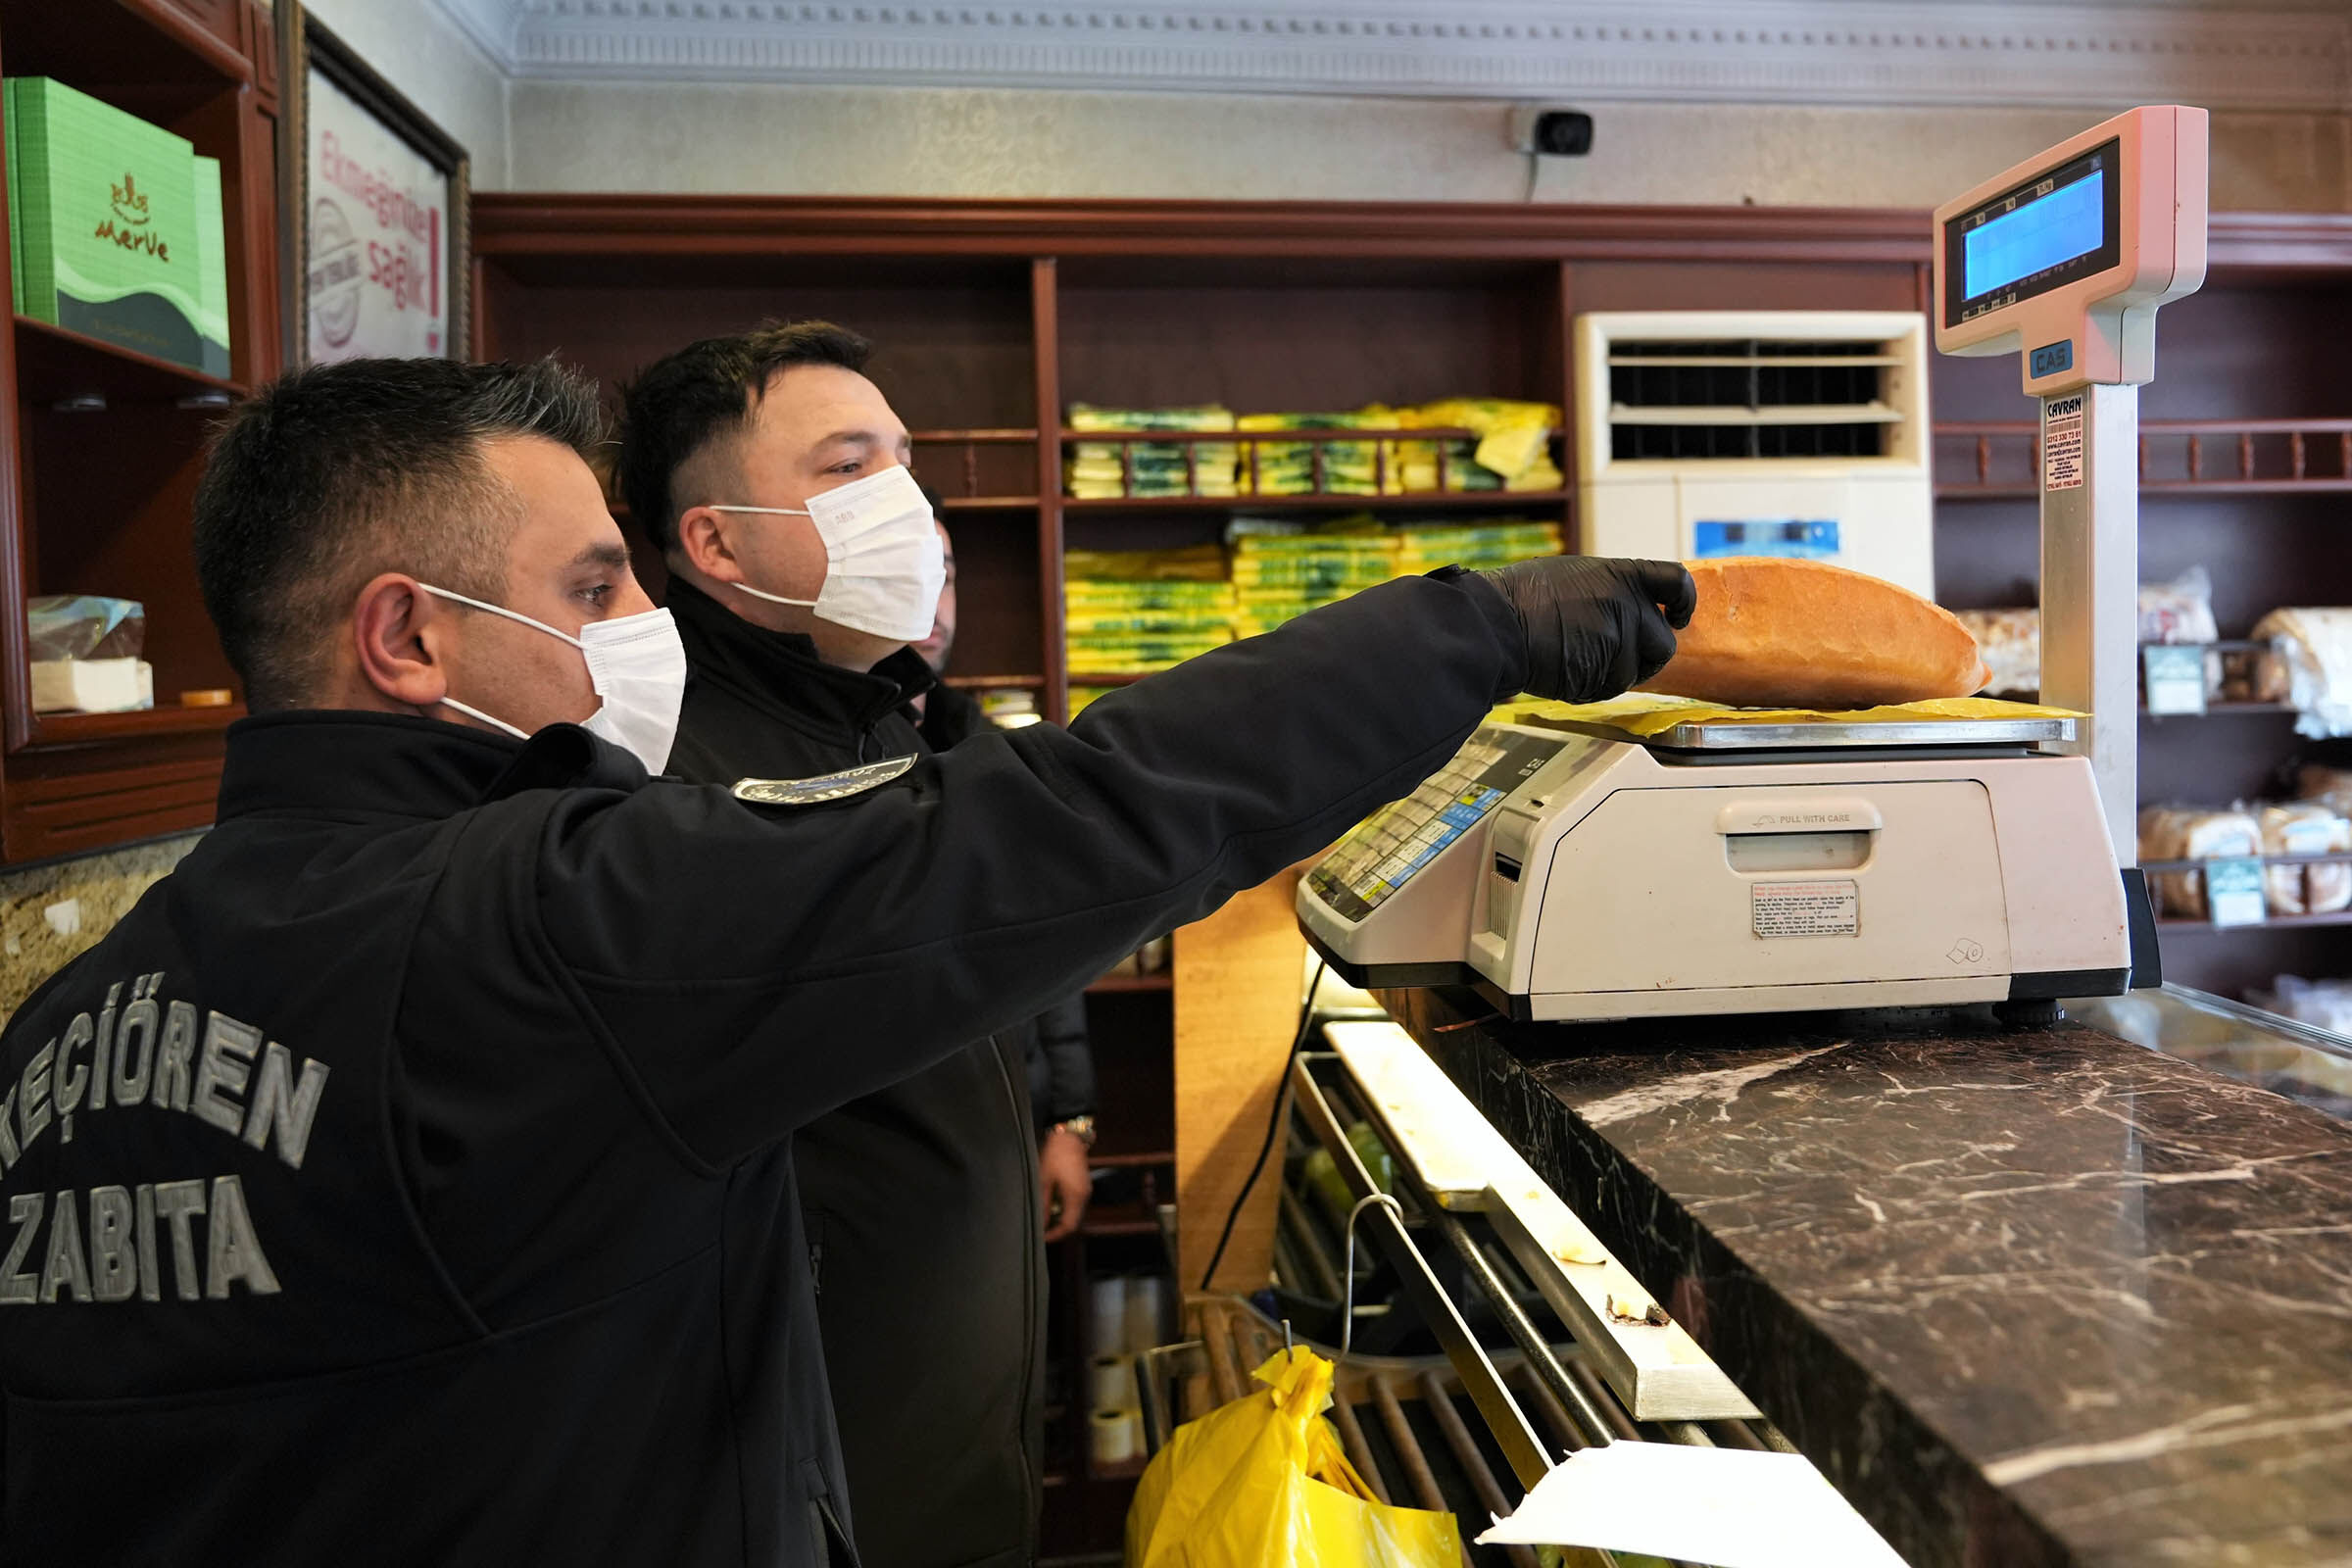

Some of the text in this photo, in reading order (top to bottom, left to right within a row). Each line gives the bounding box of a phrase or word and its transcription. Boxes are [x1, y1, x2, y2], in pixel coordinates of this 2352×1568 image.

[2036, 347, 2066, 373] CAS
[2047, 397, 2082, 417] CAVRAN
[1780, 815, 1800, 824] PULL
[1828, 814, 1851, 823] CARE
[0, 971, 331, 1170] KEÇİÖREN
[0, 1174, 282, 1304] ZABITA
